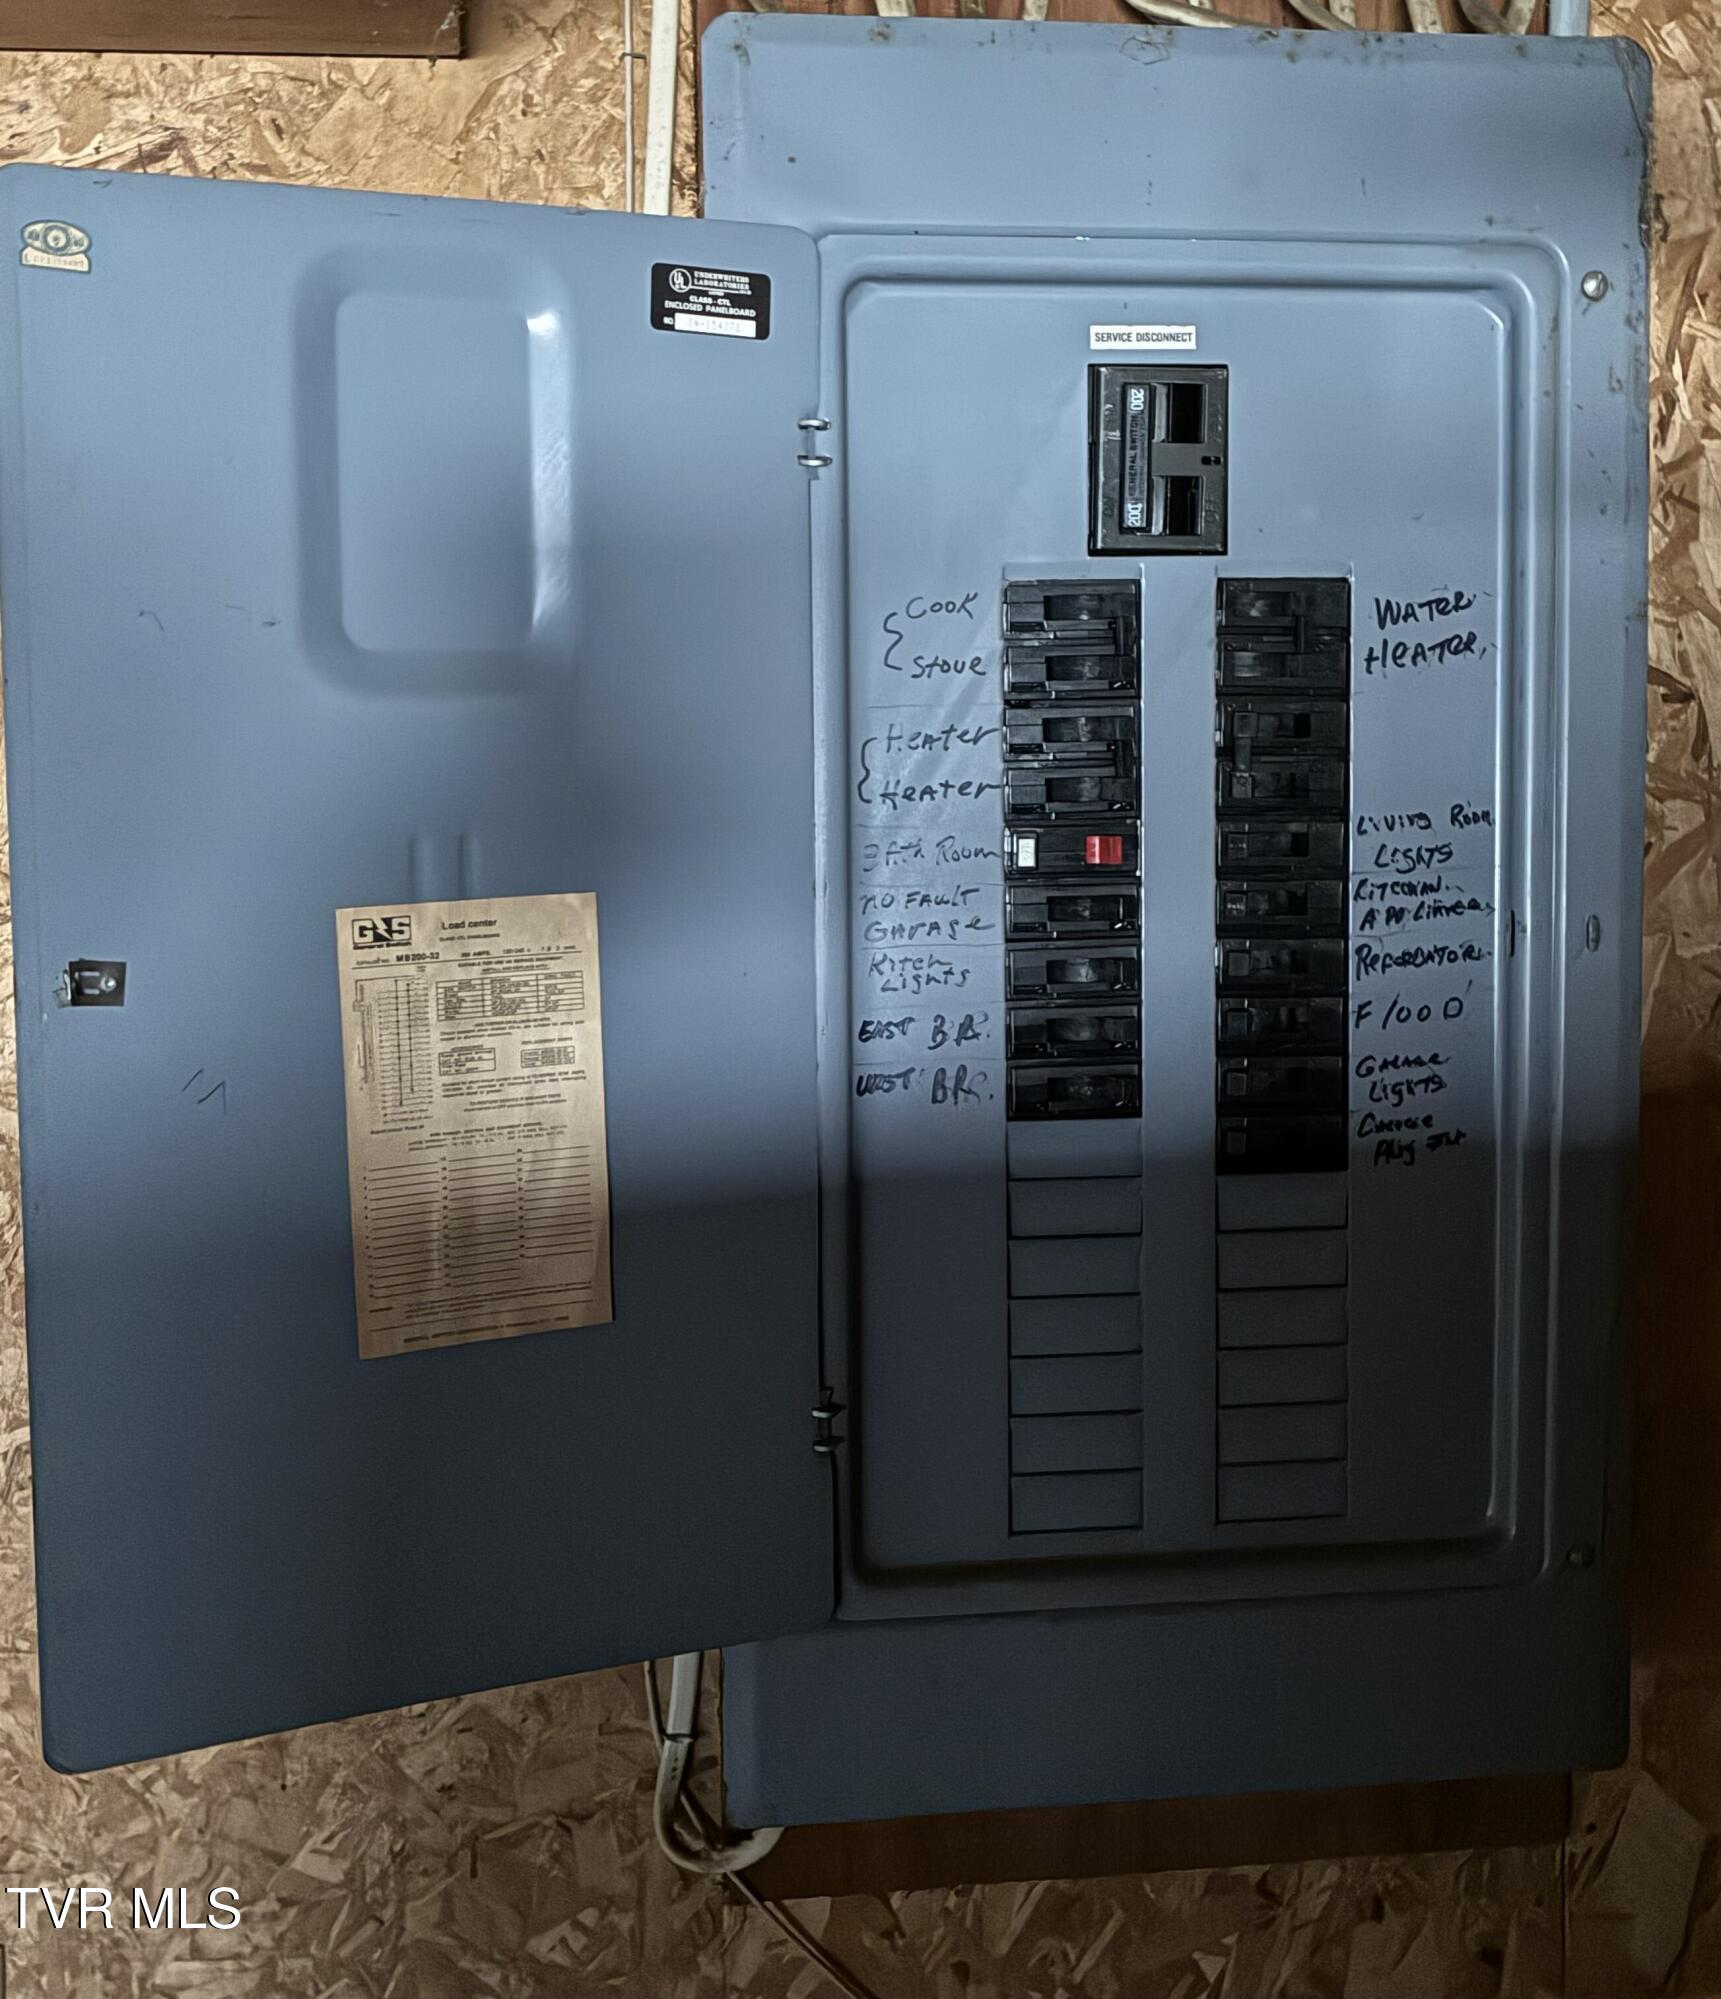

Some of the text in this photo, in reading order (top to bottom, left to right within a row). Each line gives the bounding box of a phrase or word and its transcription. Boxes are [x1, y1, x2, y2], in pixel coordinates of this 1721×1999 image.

[690, 296, 713, 304] CLASS
[665, 301, 757, 317] ENCLOSED PANELBOARD
[1094, 332, 1193, 343] SERVICE DISCONNECT
[1130, 388, 1144, 411] 200
[1127, 502, 1143, 528] 200
[442, 919, 498, 931] Load center
